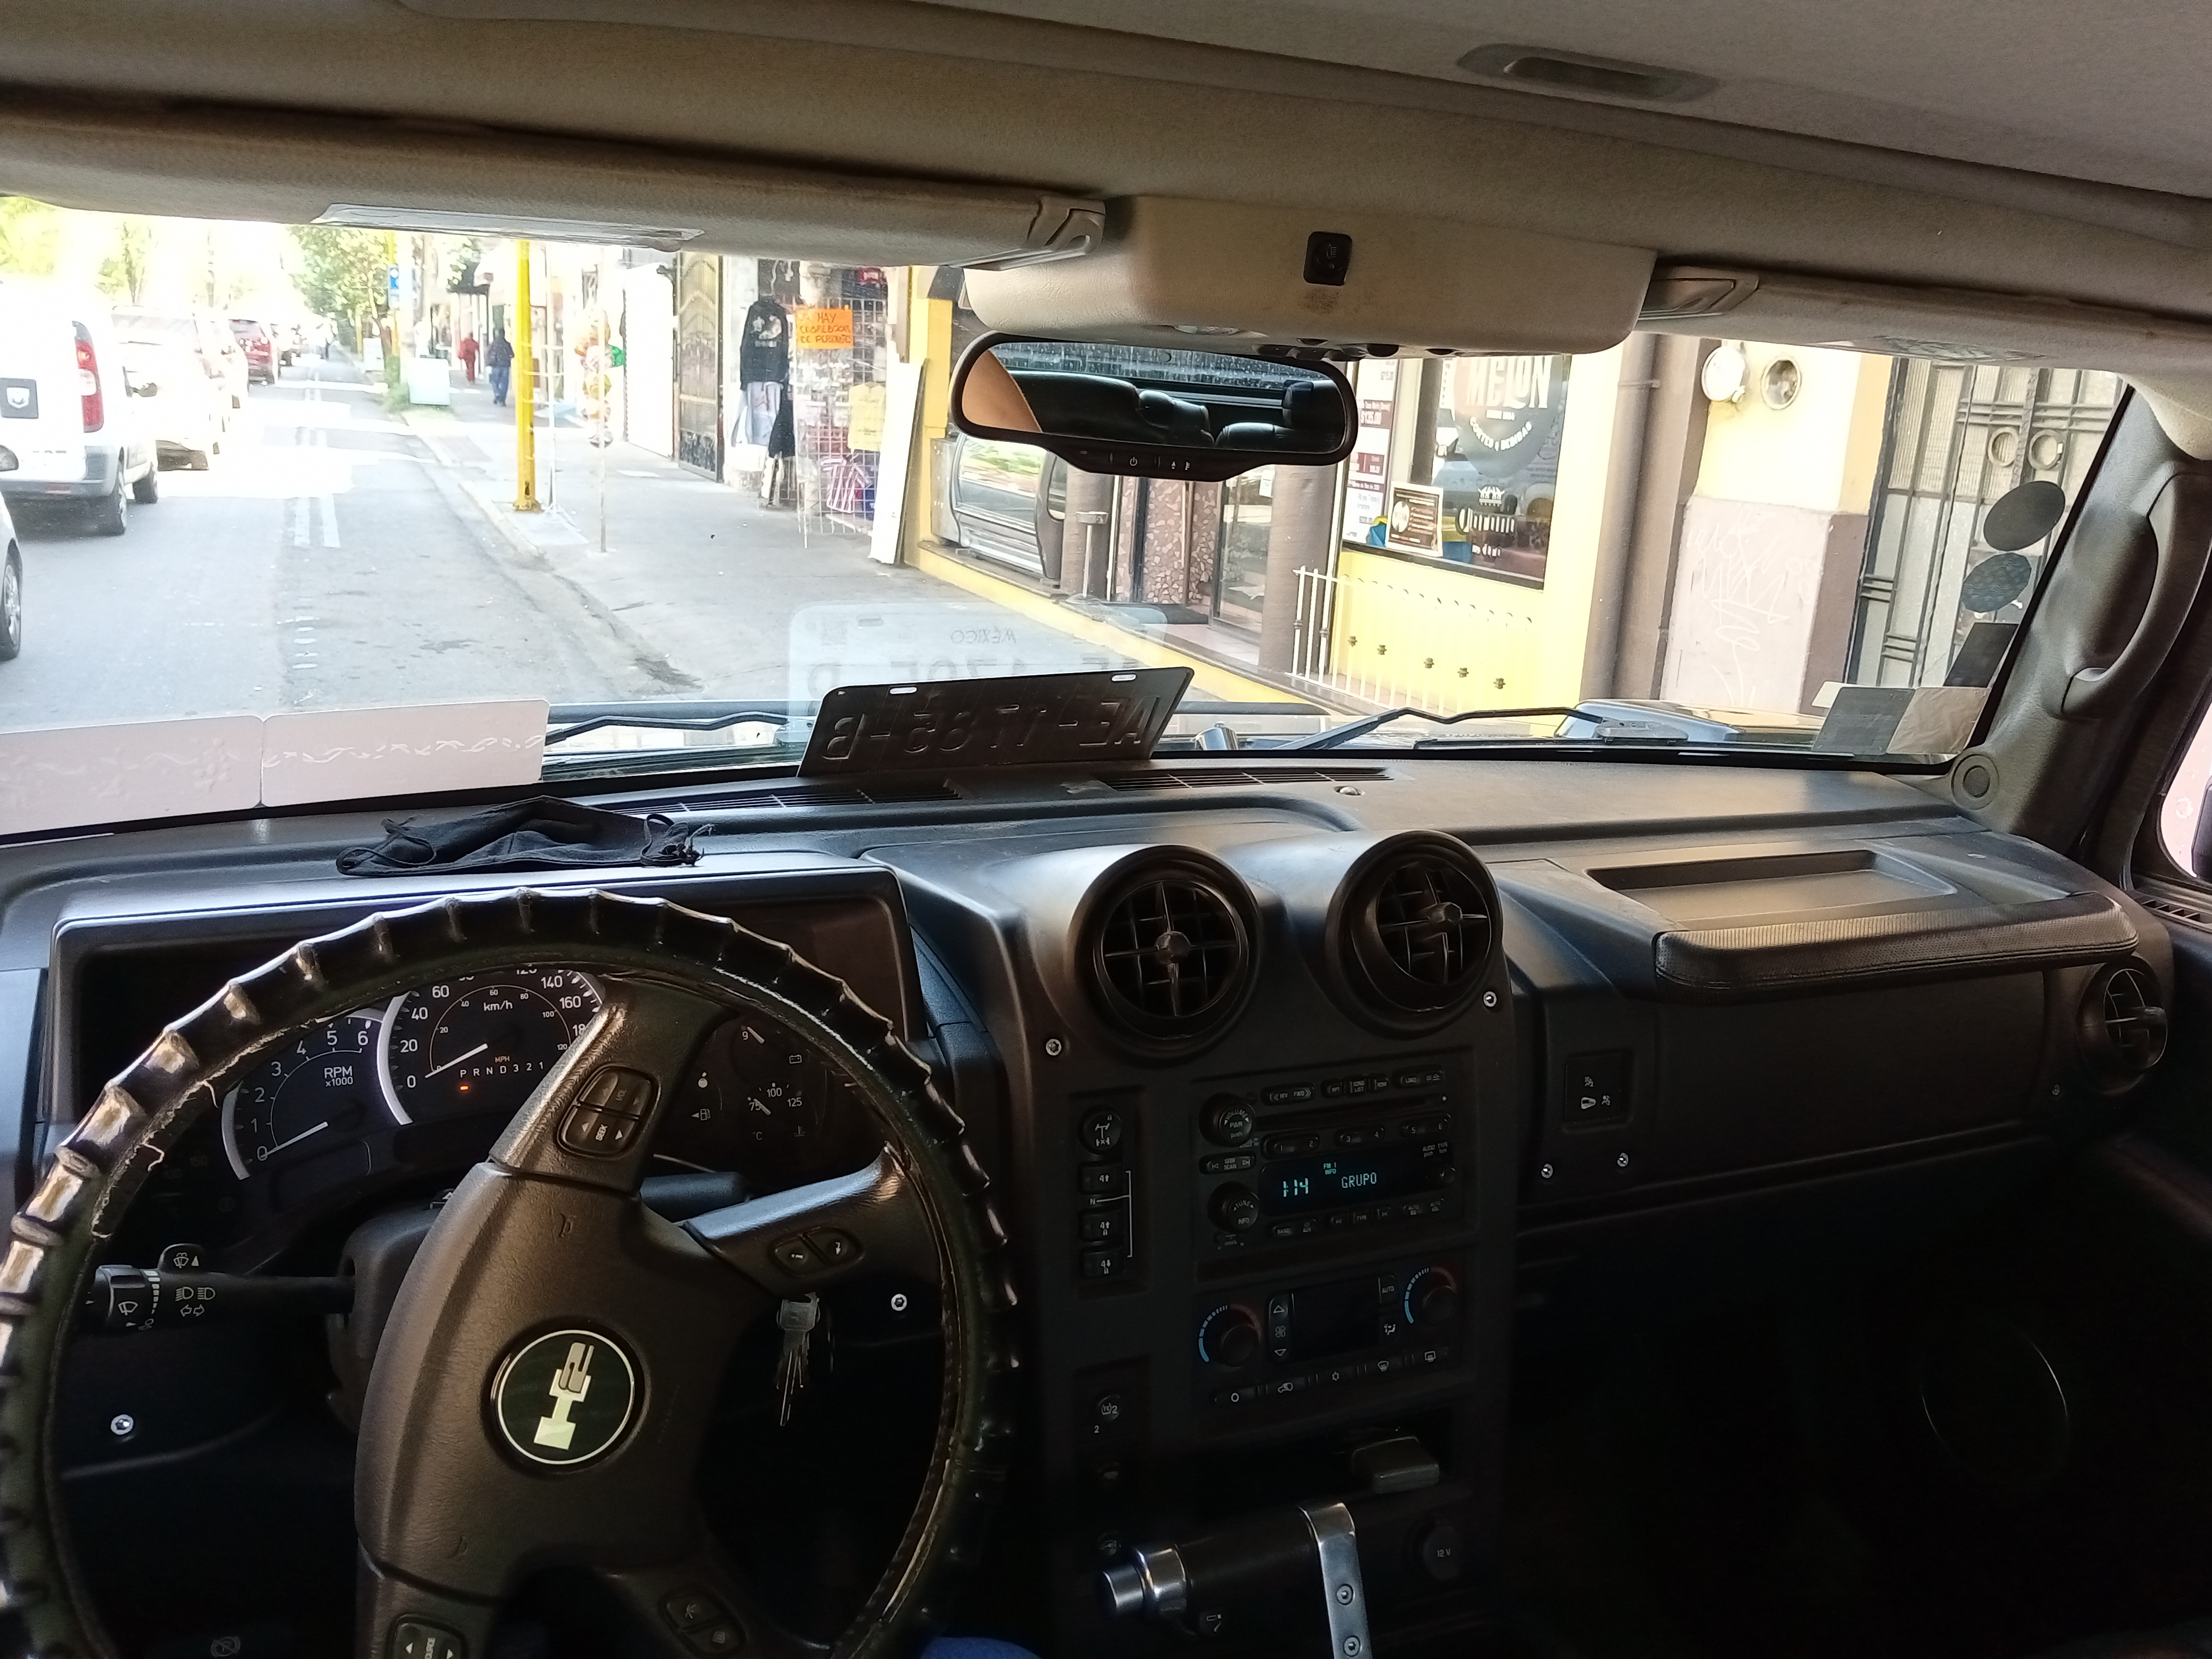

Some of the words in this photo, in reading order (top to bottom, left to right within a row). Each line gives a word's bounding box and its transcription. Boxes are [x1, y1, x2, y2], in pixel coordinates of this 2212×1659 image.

[817, 312, 837, 324] HAY
[1470, 416, 1494, 448] CORTES
[1501, 421, 1532, 450] BEBIDAS
[540, 975, 564, 989] 140
[432, 985, 450, 999] 60
[483, 1000, 513, 1012] km/h
[559, 995, 582, 1009] 160
[411, 1007, 429, 1020] 40
[326, 1030, 338, 1045] 5
[357, 1030, 369, 1046] 6
[296, 1040, 307, 1055] 4
[399, 1038, 418, 1053] 20
[270, 1061, 282, 1077] 3
[324, 1066, 353, 1079] RPM
[459, 1069, 468, 1078] P
[473, 1068, 481, 1077] R
[486, 1067, 493, 1075] N
[500, 1065, 507, 1074] D
[513, 1063, 520, 1073] 3
[526, 1062, 533, 1071] 2
[539, 1061, 543, 1070] 1
[325, 1076, 354, 1087] x1000
[406, 1075, 416, 1088] 0
[254, 1087, 266, 1103] 2
[615, 1089, 627, 1102] VOL
[766, 1087, 782, 1097] 100
[786, 1097, 803, 1108] 125
[1225, 1109, 1248, 1119] VOLUME
[250, 1118, 258, 1133] 1
[595, 1124, 608, 1141] SEEK
[1341, 1172, 1377, 1188] GRUPO
[1283, 1177, 1309, 1197] 1:14
[1090, 1197, 1096, 1205] N
[1235, 1199, 1251, 1209] TUNE
[1381, 1285, 1395, 1295] AUTO
[1094, 1425, 1100, 1434] 2
[1436, 1549, 1445, 1559] 12
[1445, 1548, 1452, 1557] V
